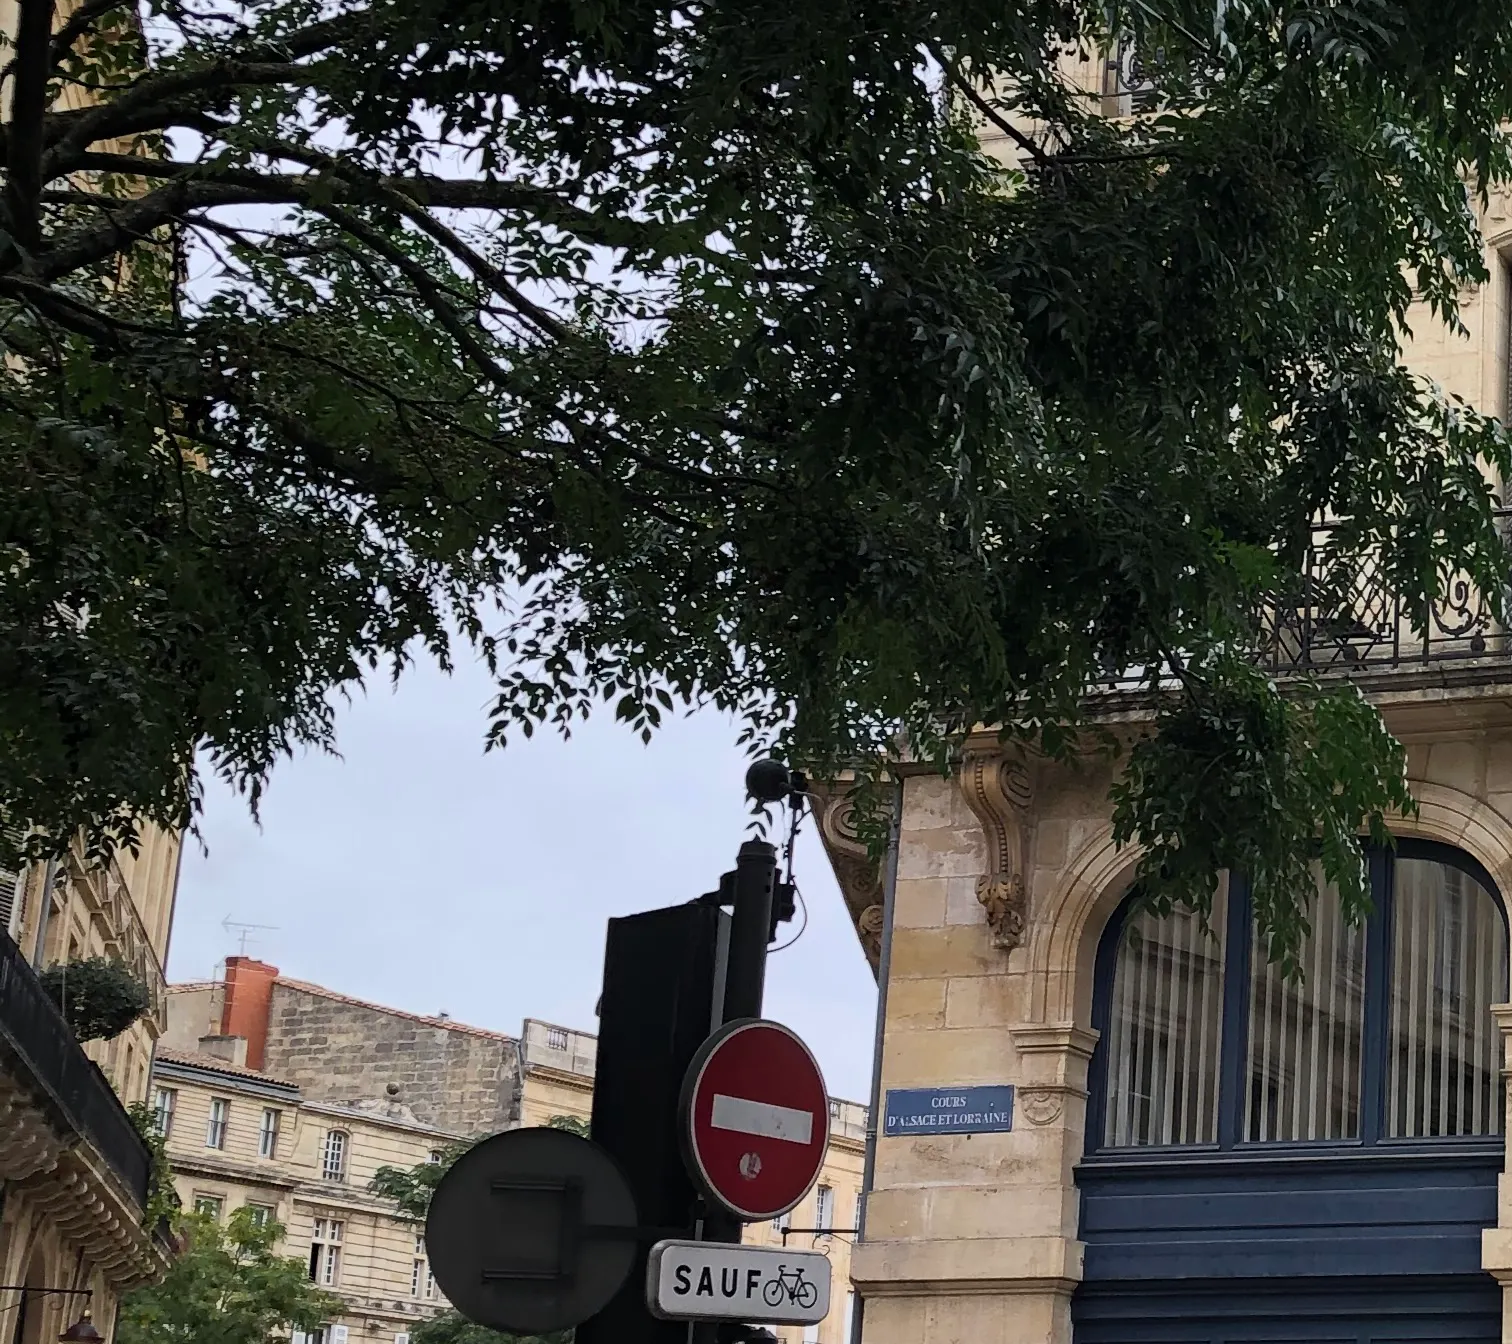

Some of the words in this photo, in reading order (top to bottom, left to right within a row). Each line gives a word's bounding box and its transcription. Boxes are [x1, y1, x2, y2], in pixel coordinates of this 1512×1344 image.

[931, 1096, 967, 1108] COURS
[938, 1114, 952, 1125] ET
[954, 1112, 1008, 1124] LORRAINE
[673, 1264, 762, 1299] SAUF
